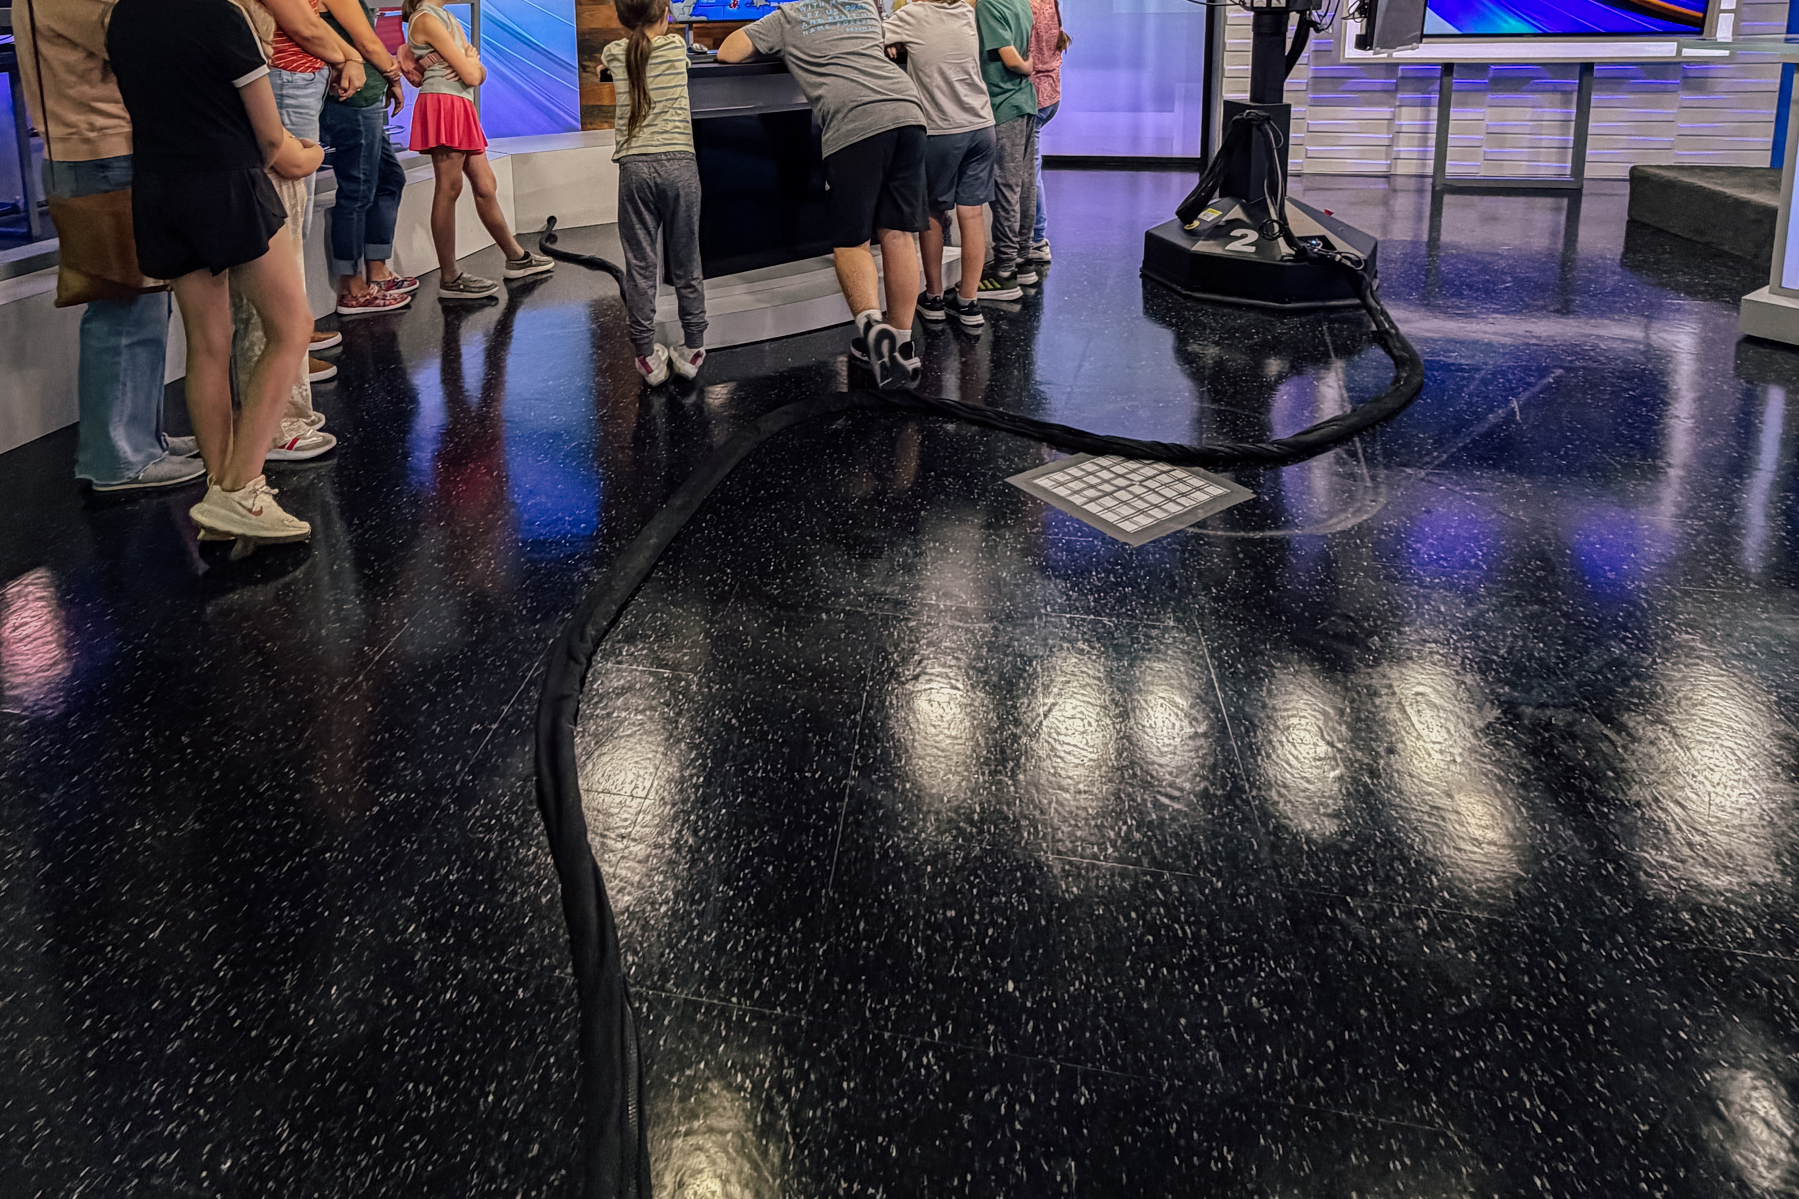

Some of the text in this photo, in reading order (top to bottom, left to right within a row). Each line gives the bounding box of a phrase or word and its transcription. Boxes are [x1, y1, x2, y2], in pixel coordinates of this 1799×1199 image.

[799, 1, 825, 13] WITH
[803, 24, 830, 37] NAME
[1225, 228, 1259, 253] 2
